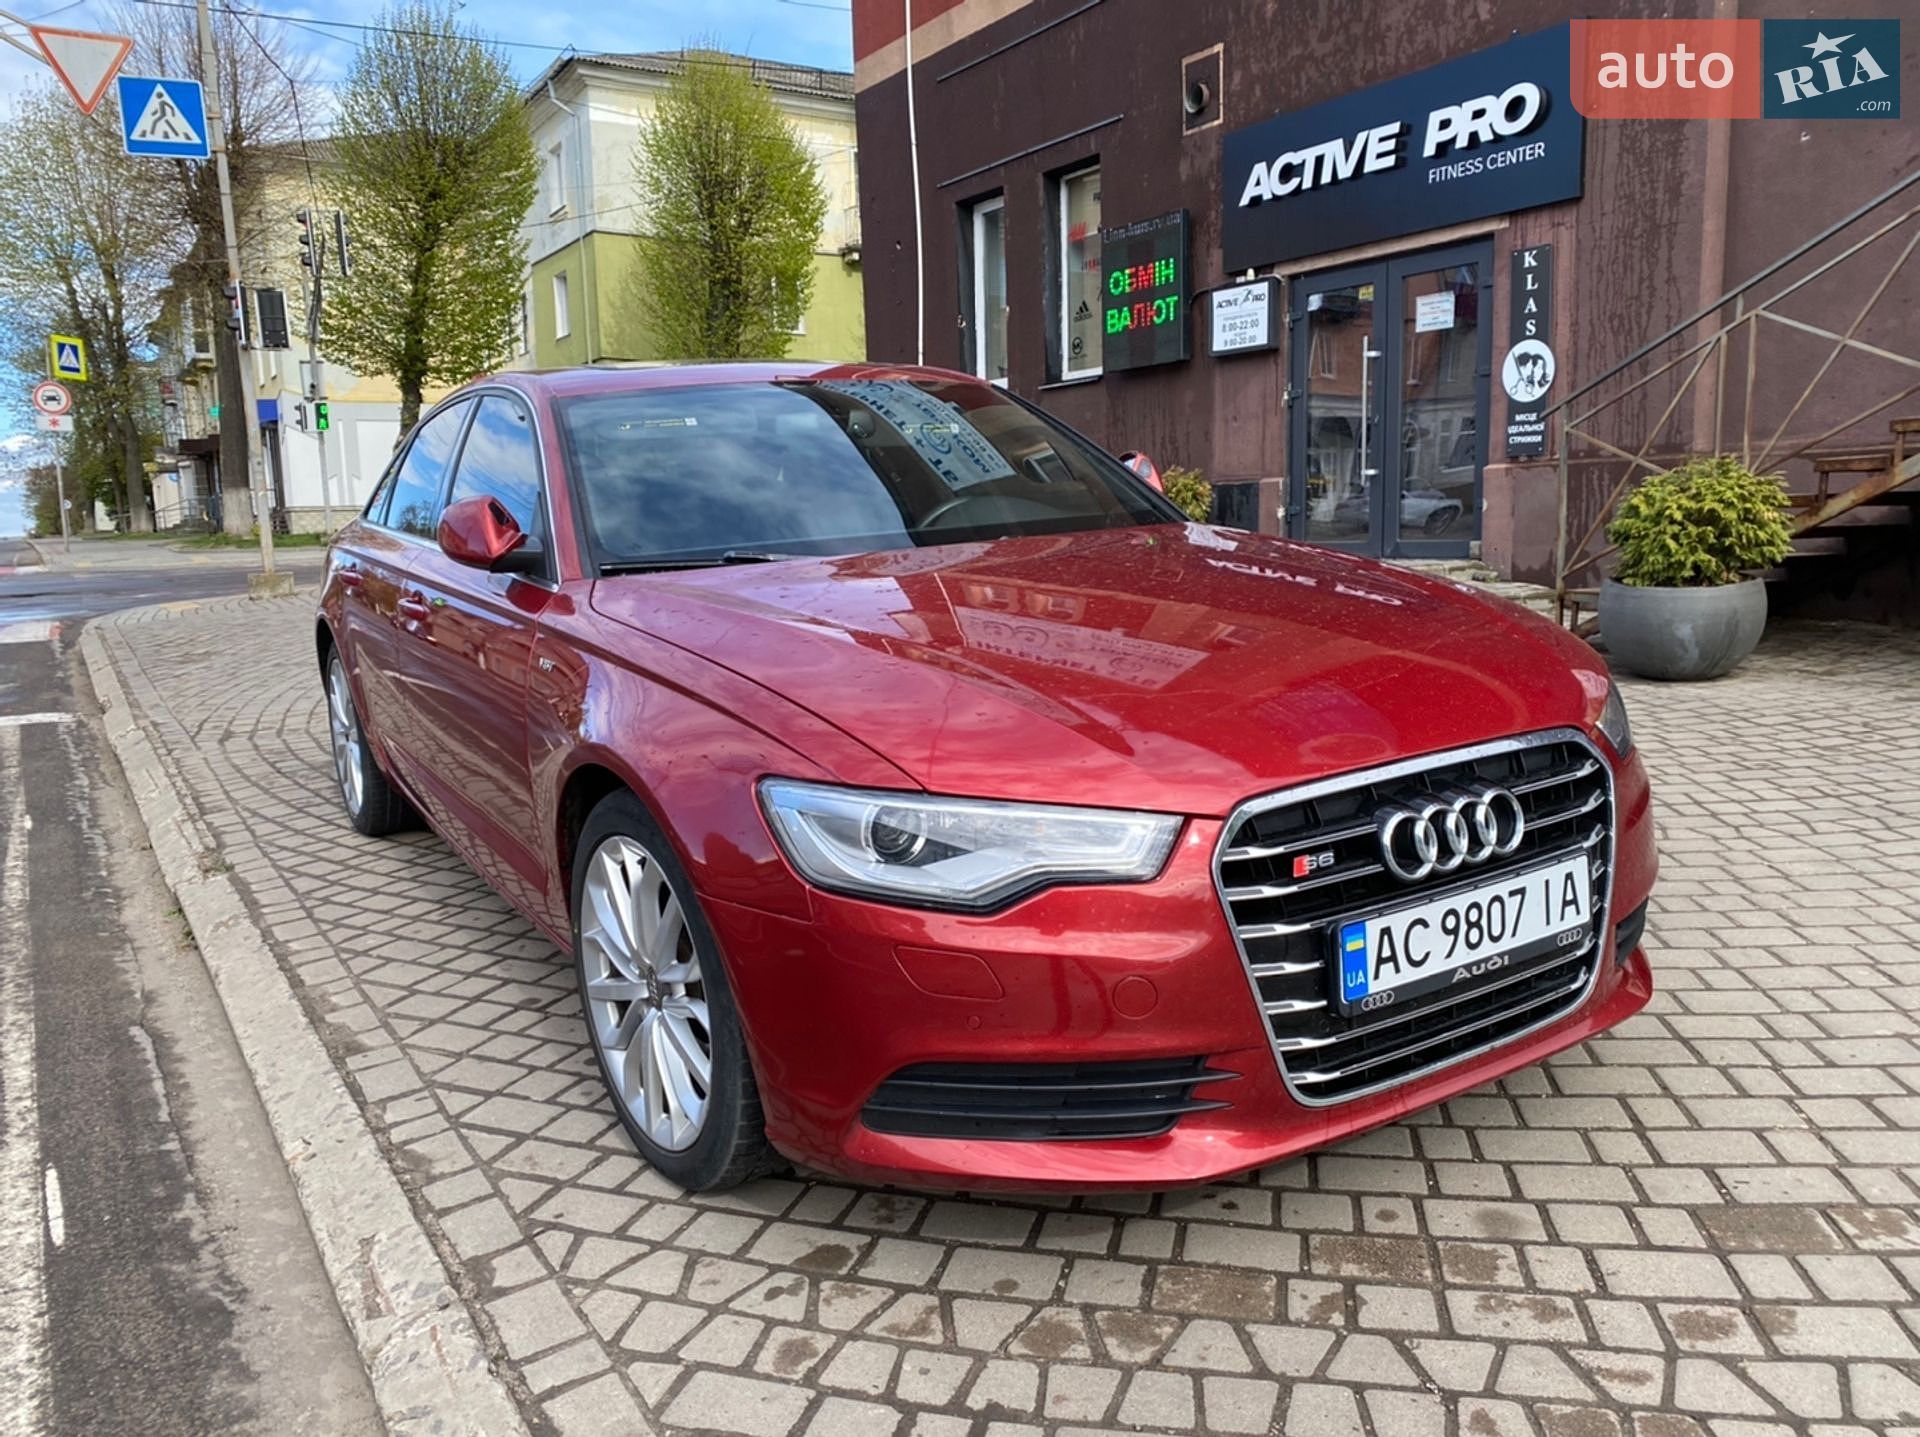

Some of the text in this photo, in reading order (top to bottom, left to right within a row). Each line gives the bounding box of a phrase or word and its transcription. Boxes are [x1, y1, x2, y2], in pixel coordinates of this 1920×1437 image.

[1238, 81, 1542, 207] ACTIVE PRO
[1428, 142, 1545, 184] FITNESS CENTER
[1109, 257, 1175, 296] ОБМІН
[1523, 250, 1538, 336] KLAS
[1106, 295, 1179, 336] ВАЛЮТ
[1305, 852, 1335, 871] S6
[1373, 871, 1581, 981] AC 9807 IA
[1346, 972, 1366, 988] UA
[1452, 954, 1510, 983] Audi
